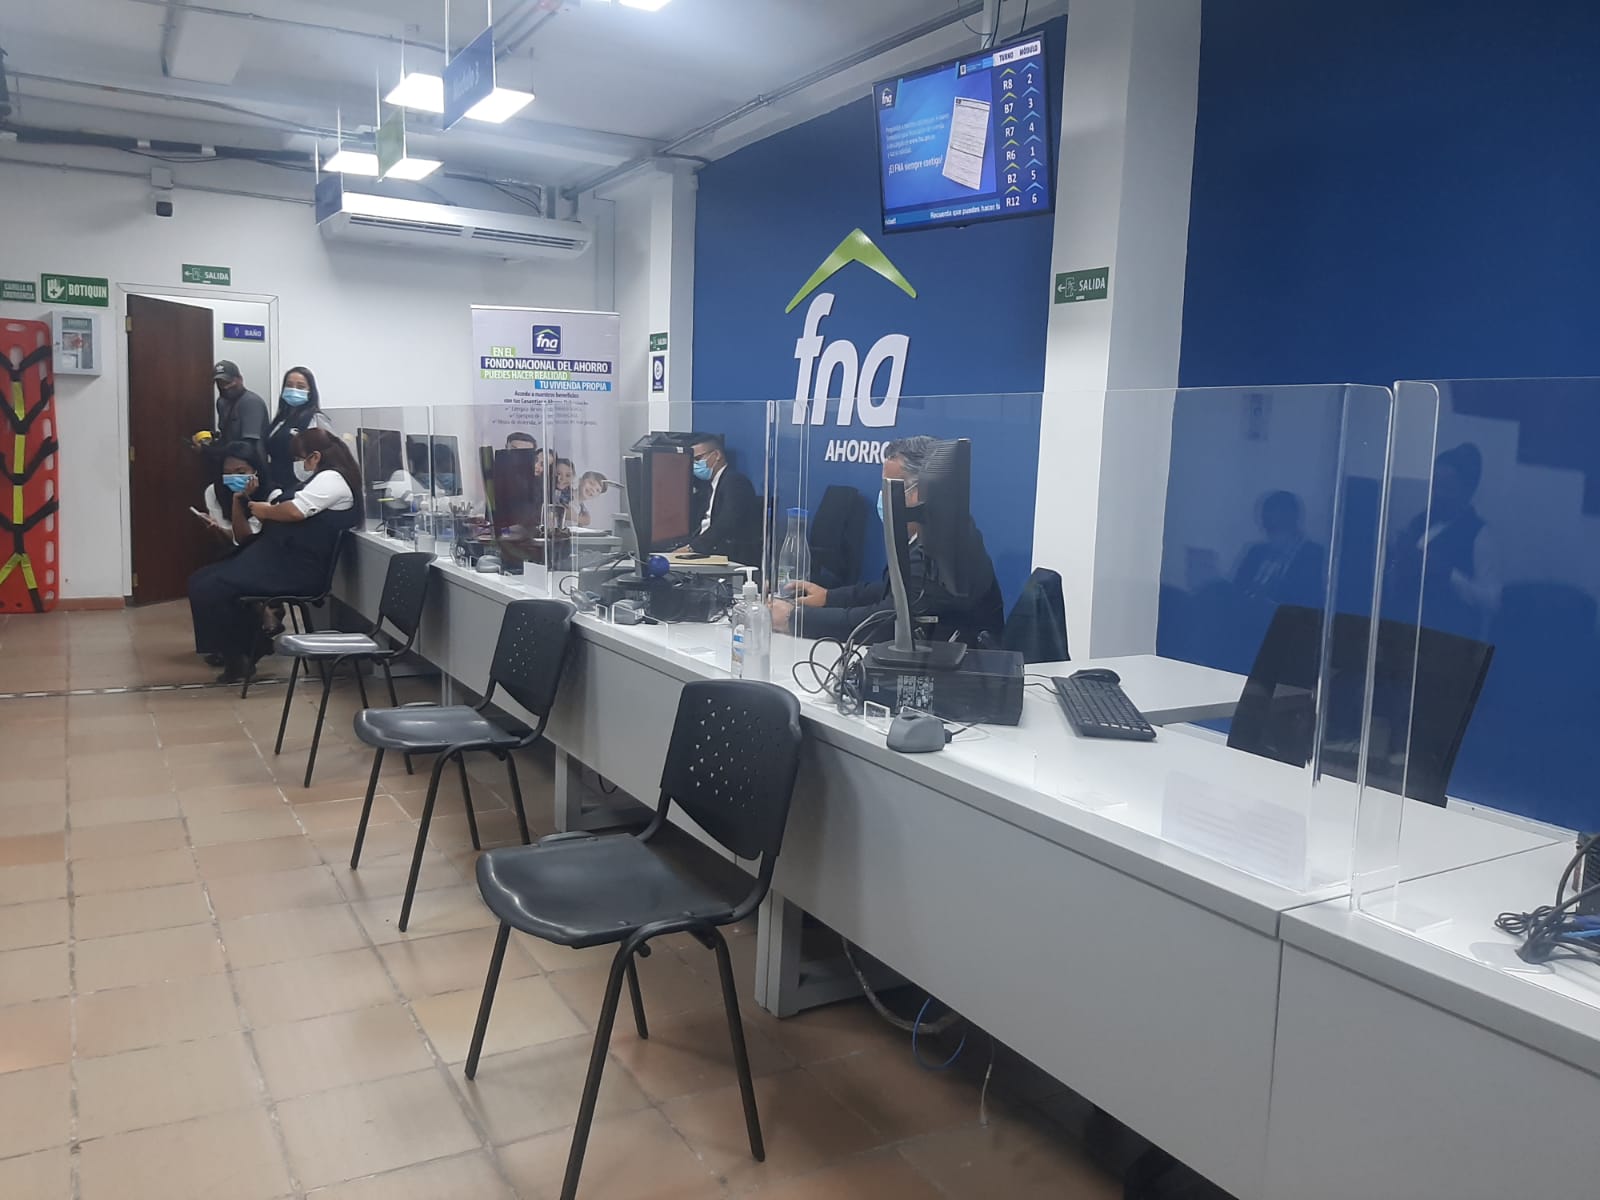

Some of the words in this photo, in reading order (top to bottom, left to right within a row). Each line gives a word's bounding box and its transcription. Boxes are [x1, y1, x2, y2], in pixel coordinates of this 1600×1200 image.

[999, 51, 1014, 62] TURNO
[1003, 79, 1013, 90] R8
[1027, 73, 1032, 84] 2
[1004, 103, 1014, 114] B7
[1028, 97, 1033, 108] 3
[1005, 126, 1015, 137] R7
[1028, 122, 1034, 132] 4
[1006, 150, 1016, 160] R6
[1030, 146, 1035, 156] 1
[1007, 173, 1017, 184] B2
[1031, 169, 1036, 180] 5
[1006, 196, 1020, 207] R12
[1032, 193, 1037, 204] 6
[204, 271, 229, 280] SALIDA
[68, 283, 107, 299] BOTIQUIN
[1078, 277, 1106, 291] SALIDA
[244, 329, 262, 337] BAÑO
[536, 333, 558, 348] fna
[492, 346, 503, 357] EN
[504, 347, 514, 357] EL
[485, 358, 514, 370] FONDO
[515, 359, 556, 371] NACIONAL
[557, 361, 572, 371] DEL
[573, 362, 609, 373] AHORRO
[792, 292, 910, 427] fna
[484, 370, 511, 379] PUEDES
[511, 371, 534, 380] HACER
[534, 371, 568, 380] REALIDAD
[539, 381, 548, 389] TU
[549, 381, 581, 390] VIVIENDA
[581, 383, 607, 391] PROPIA
